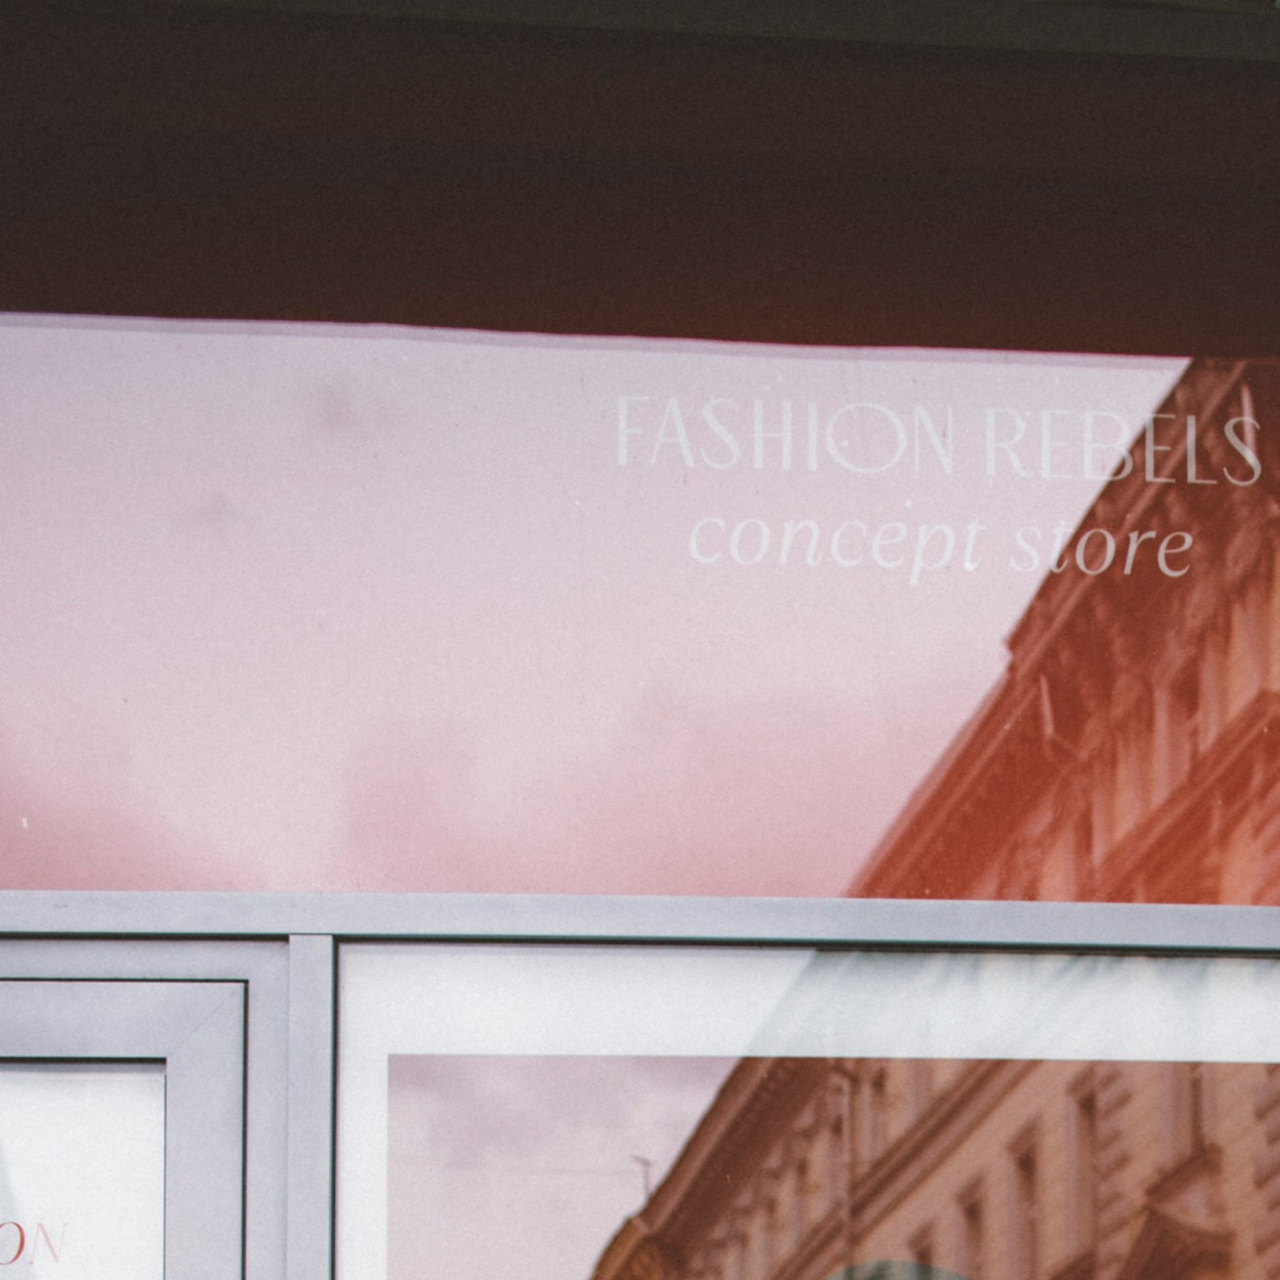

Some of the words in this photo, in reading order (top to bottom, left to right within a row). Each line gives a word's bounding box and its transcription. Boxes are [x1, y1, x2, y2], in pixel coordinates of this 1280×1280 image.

[616, 395, 954, 475] FASHION
[985, 407, 1264, 487] REBELS
[688, 512, 987, 586] concept
[1009, 516, 1194, 578] store
